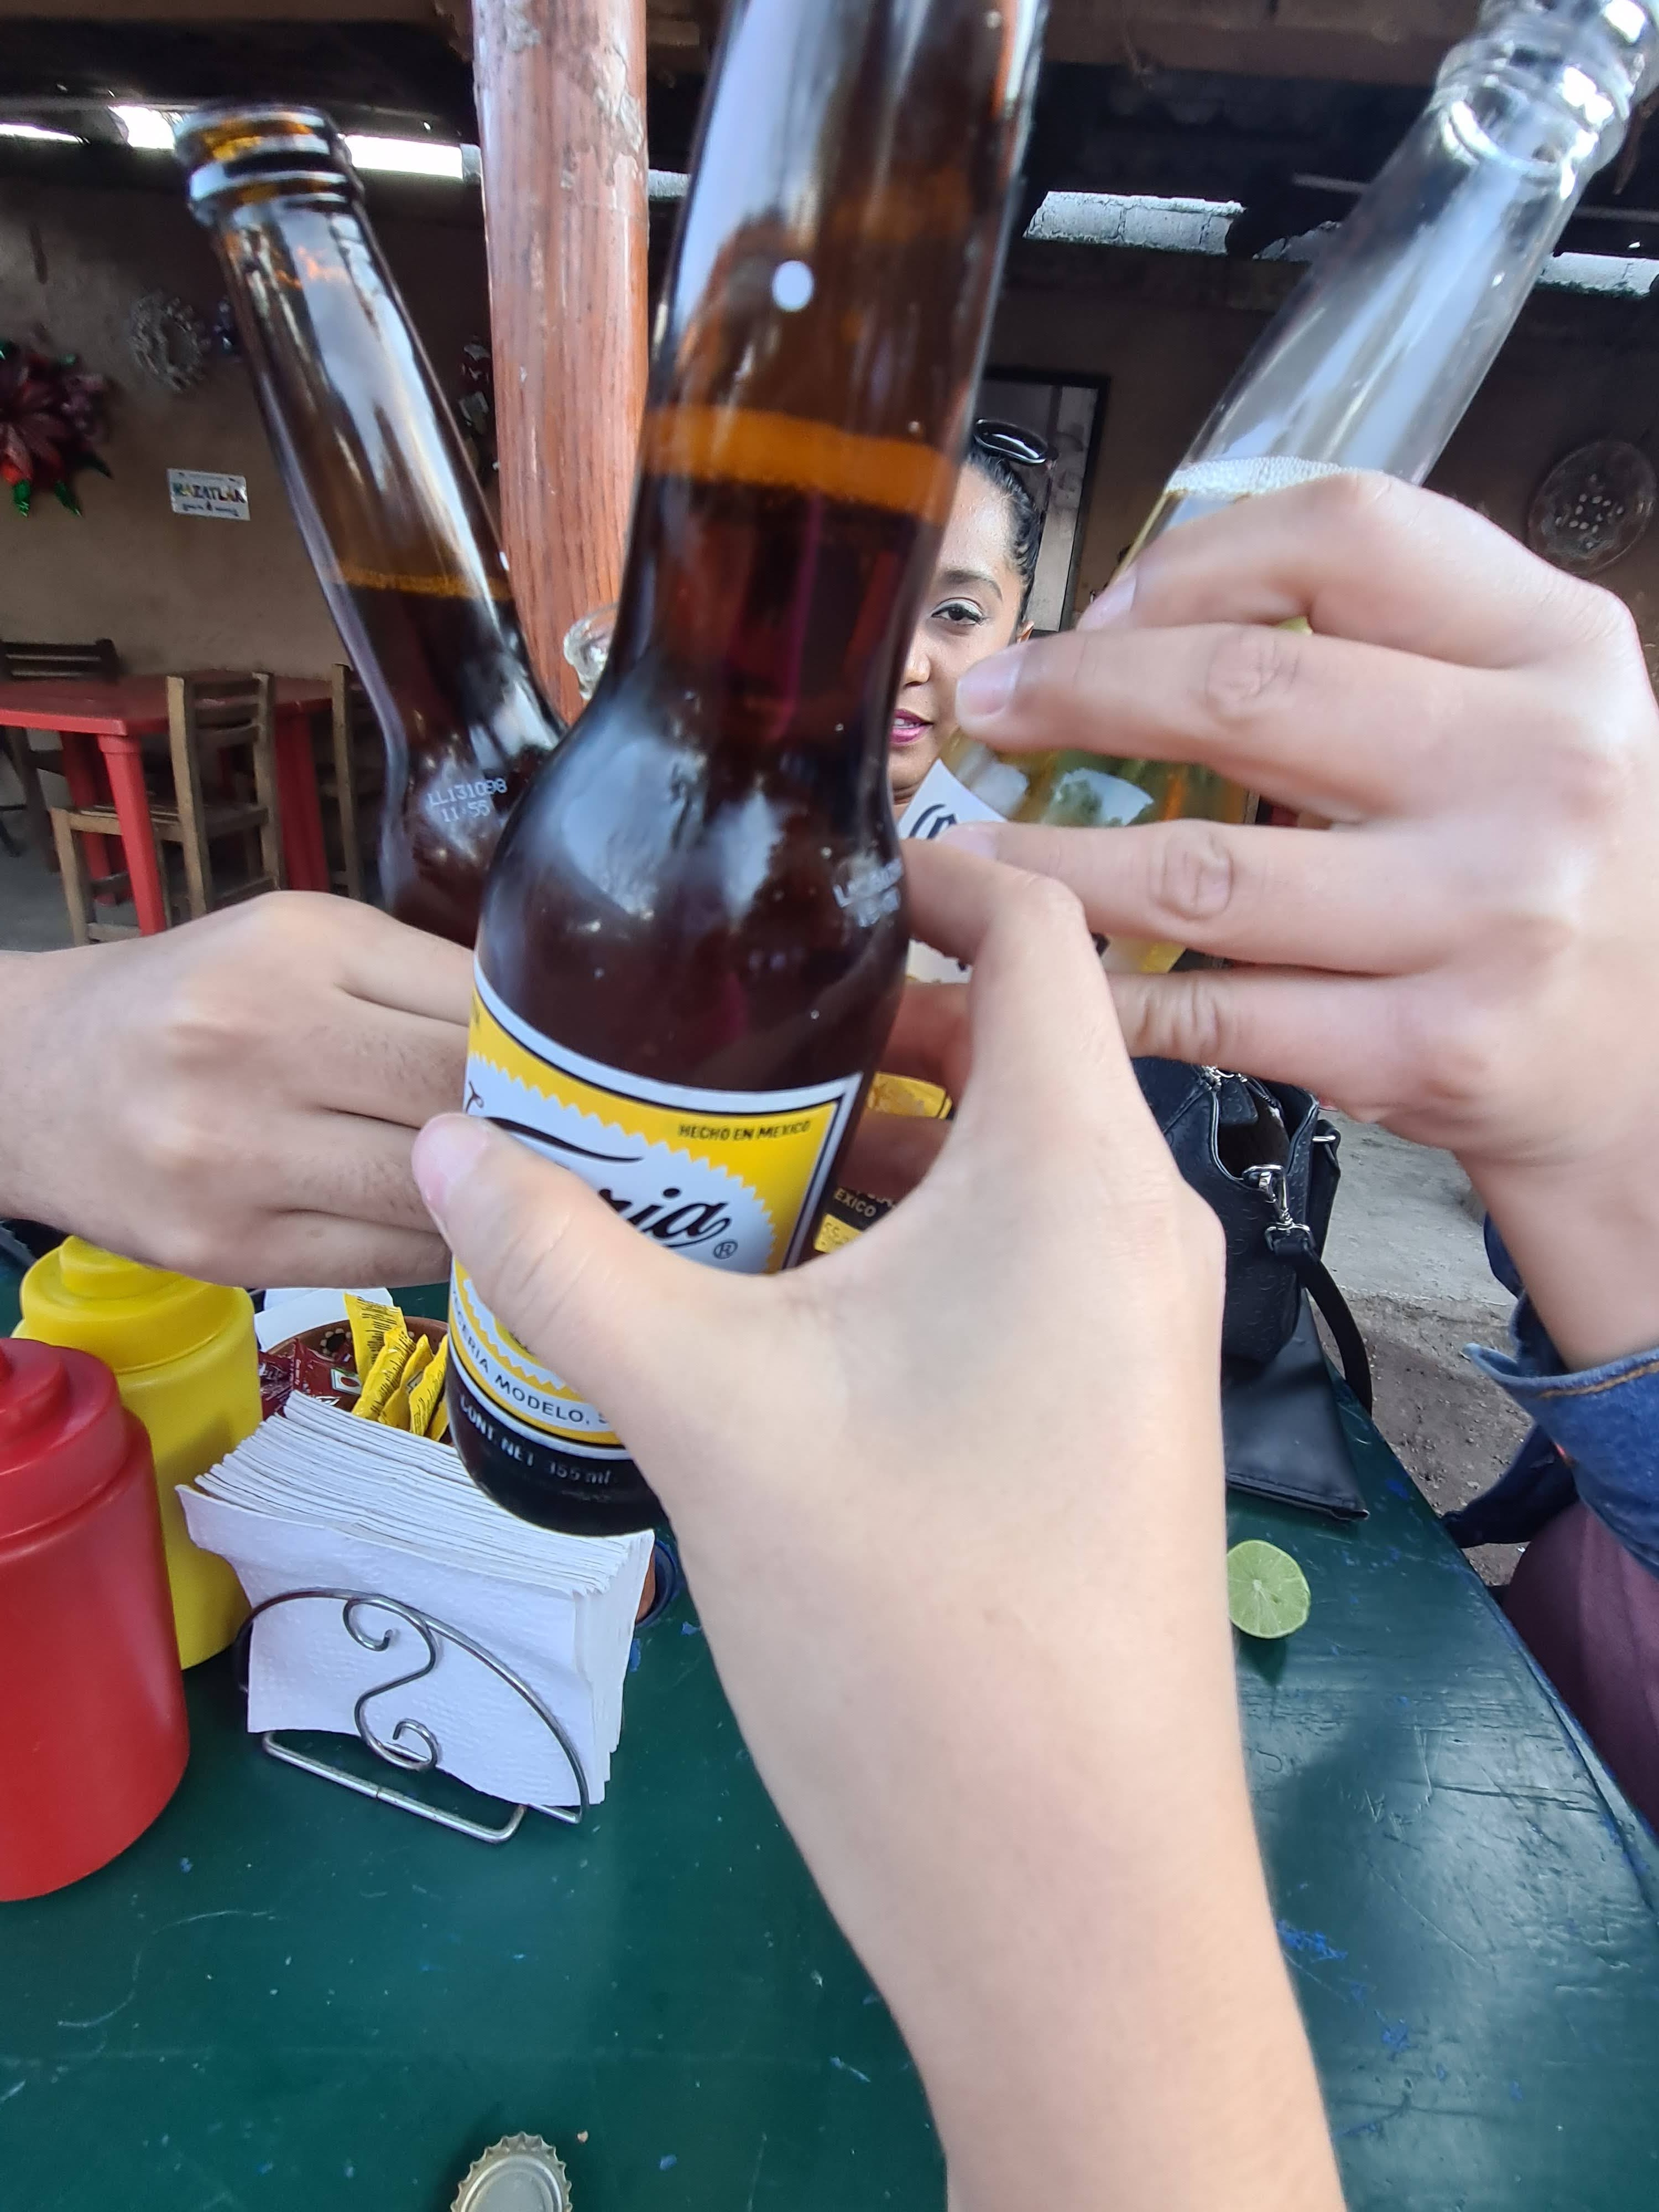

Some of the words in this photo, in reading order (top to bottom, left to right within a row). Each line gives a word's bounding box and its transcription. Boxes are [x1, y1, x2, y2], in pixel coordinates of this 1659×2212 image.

[678, 1124, 731, 1141] HECHO
[733, 1127, 754, 1141] EN
[758, 1120, 811, 1139] MEXICO
[834, 1187, 877, 1218] EXICO
